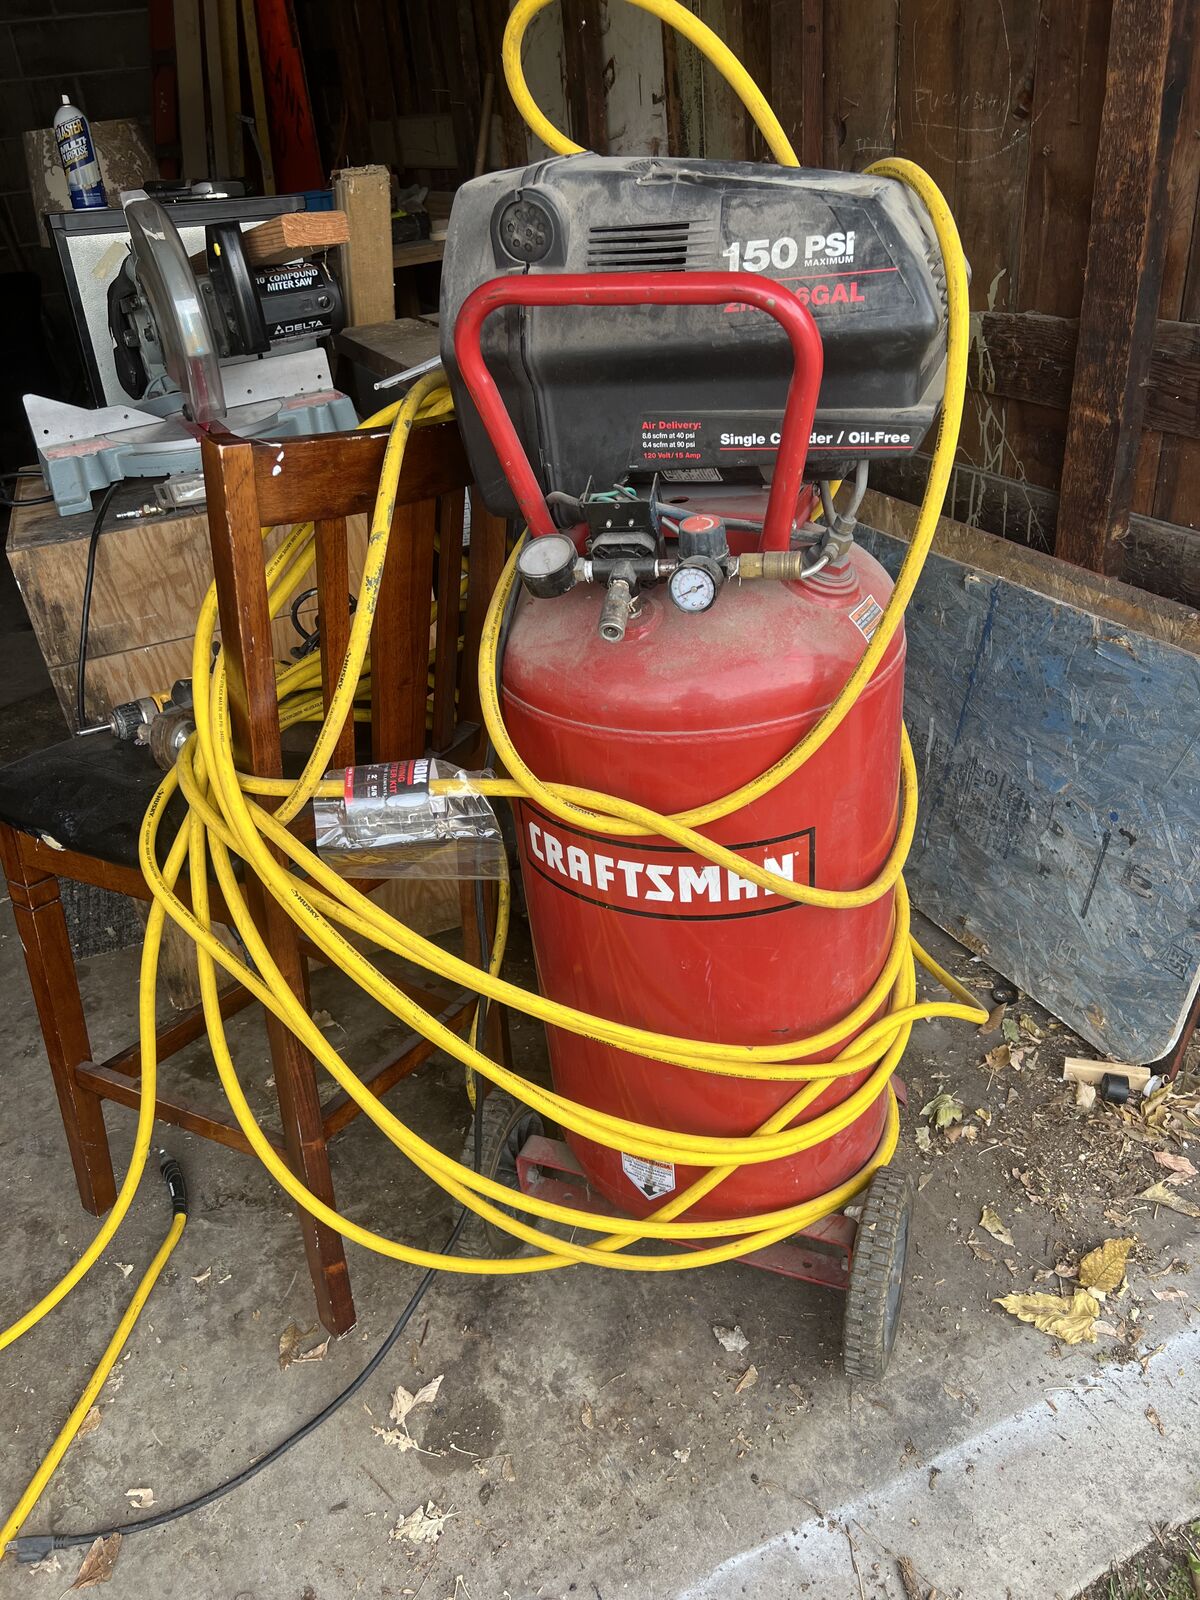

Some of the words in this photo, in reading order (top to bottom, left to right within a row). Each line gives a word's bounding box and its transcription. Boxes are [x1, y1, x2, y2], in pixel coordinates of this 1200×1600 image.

[805, 231, 856, 259] PSI
[722, 236, 798, 272] 150
[804, 256, 854, 267] MAXIMUM
[269, 268, 319, 283] COMPOUND
[267, 280, 295, 293] MITER
[294, 277, 313, 289] SAW
[795, 282, 865, 306] 6GAL
[285, 319, 324, 333] DELTA
[641, 421, 656, 430] Air
[658, 420, 702, 431] Delivery:
[652, 431, 668, 439] scfm
[668, 431, 676, 439] at
[676, 431, 685, 439] 40
[685, 431, 696, 440] psi
[720, 432, 766, 447] Single
[770, 432, 833, 444] Cder
[848, 431, 911, 444] Oil-Free
[676, 440, 685, 448] 90
[685, 440, 696, 449] psi
[685, 452, 701, 460] Amp
[528, 821, 795, 903] CRAFTSMAN
